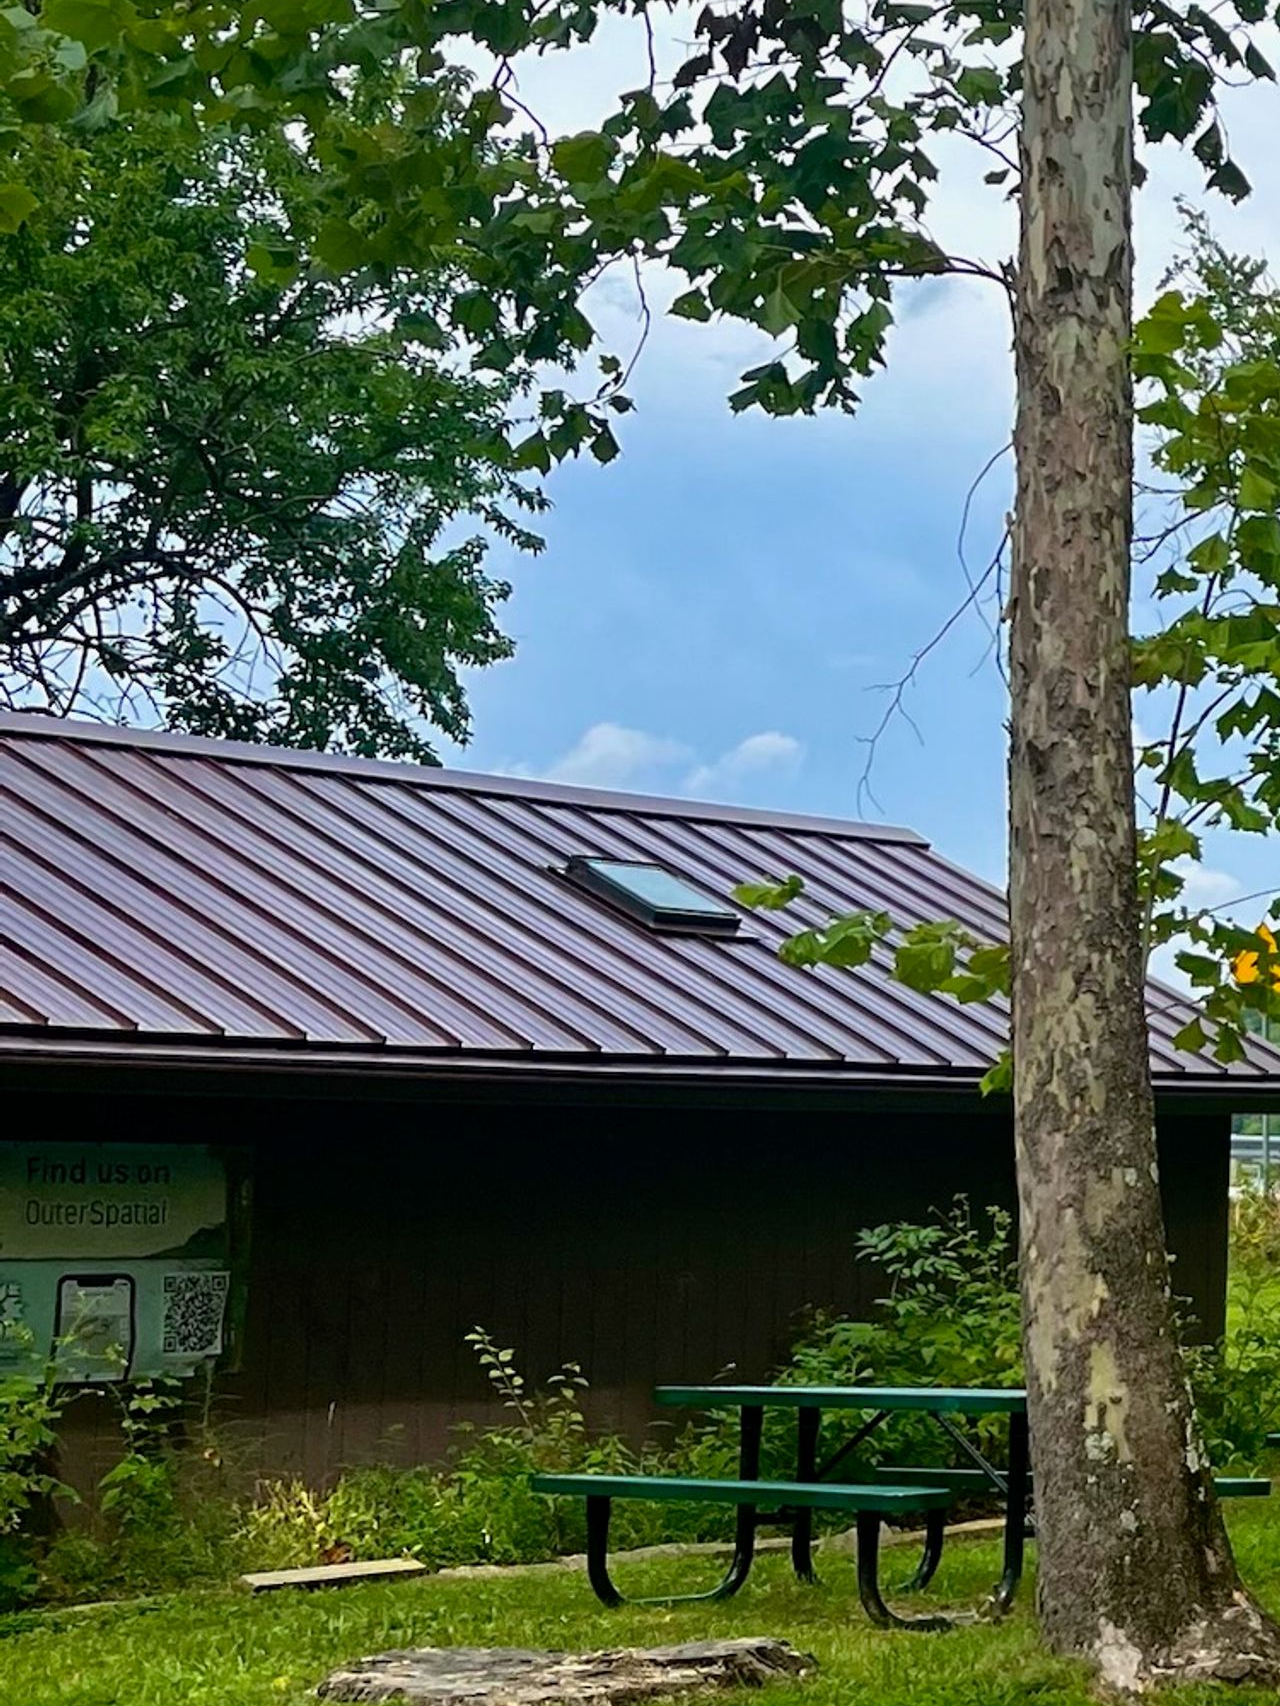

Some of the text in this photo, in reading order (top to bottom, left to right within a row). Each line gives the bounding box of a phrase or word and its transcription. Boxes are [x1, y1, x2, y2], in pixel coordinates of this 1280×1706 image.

[26, 1156, 171, 1184] Find us on
[25, 1199, 167, 1228] OuterSpatial
